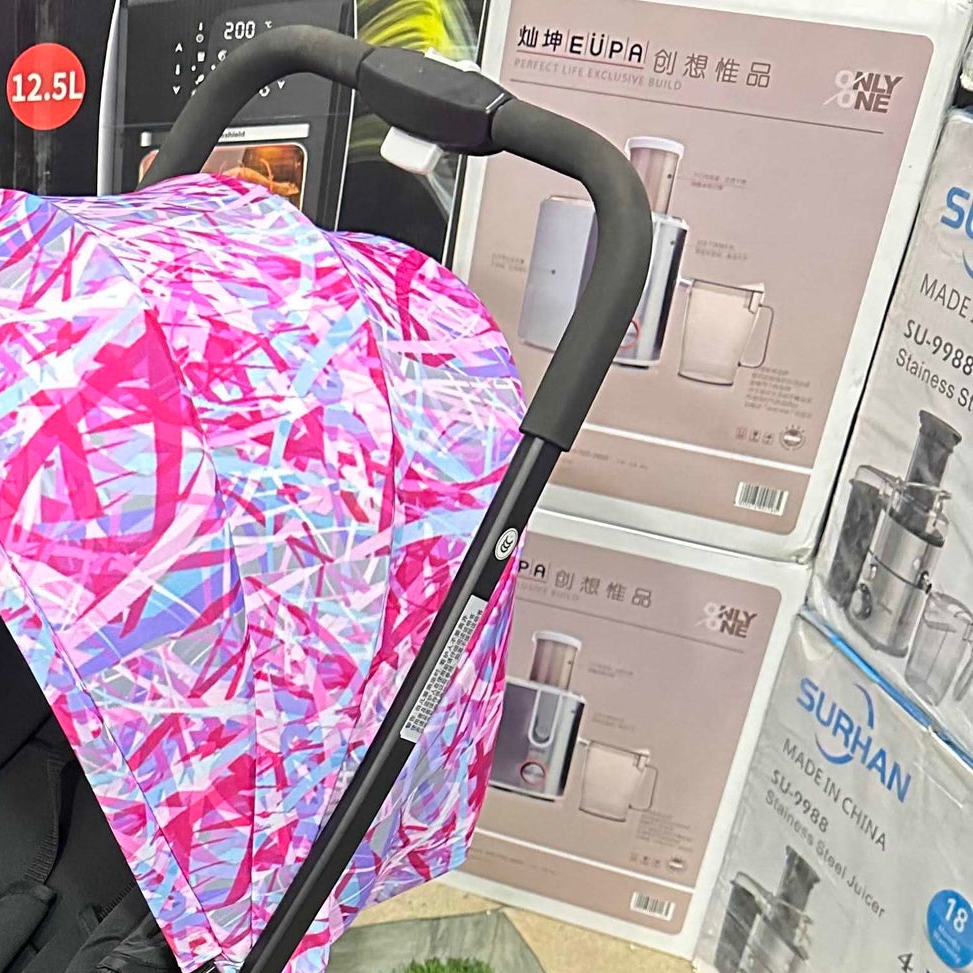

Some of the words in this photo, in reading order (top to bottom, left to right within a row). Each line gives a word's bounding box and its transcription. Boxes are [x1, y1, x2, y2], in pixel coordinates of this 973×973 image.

[224, 21, 256, 40] 200
[11, 71, 84, 103] 12.5L
[514, 58, 559, 74] PERFECT
[561, 64, 585, 78] LIFE
[587, 68, 645, 87] EXCLUSIVE
[647, 76, 683, 91] BUILD
[919, 273, 972, 320] MADE
[903, 318, 973, 376] SU-9988
[895, 348, 956, 400] Stainess
[796, 677, 912, 804] SURHAN
[771, 770, 829, 834] SU-9988
[783, 738, 824, 787] MADE
[823, 778, 842, 803] IN
[841, 796, 887, 852] CHINA
[765, 790, 815, 846] Stainess
[815, 840, 848, 879] Steel
[847, 875, 885, 919] Juicer
[945, 898, 969, 933] 18
[897, 952, 913, 973] 4
